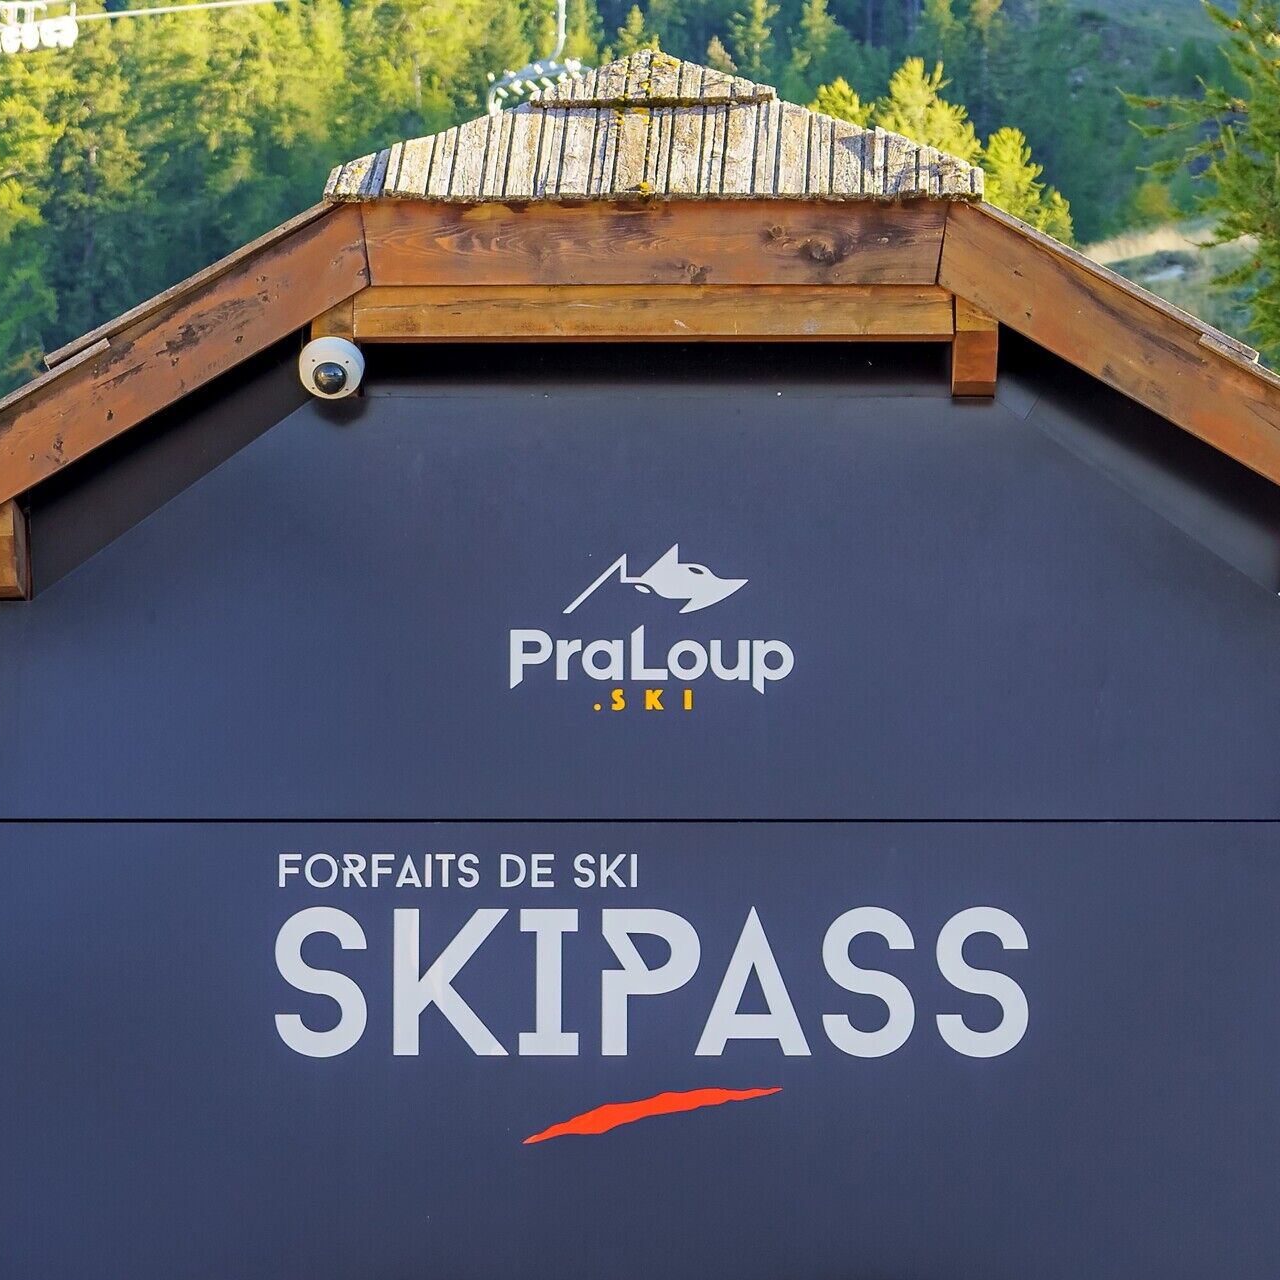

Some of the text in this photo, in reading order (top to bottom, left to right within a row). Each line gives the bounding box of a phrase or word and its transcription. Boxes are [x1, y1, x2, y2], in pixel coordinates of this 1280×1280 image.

[510, 625, 795, 694] PraLoup
[278, 853, 639, 889] FORFAITS DE SKI
[274, 906, 1029, 1058] SKIPASS
